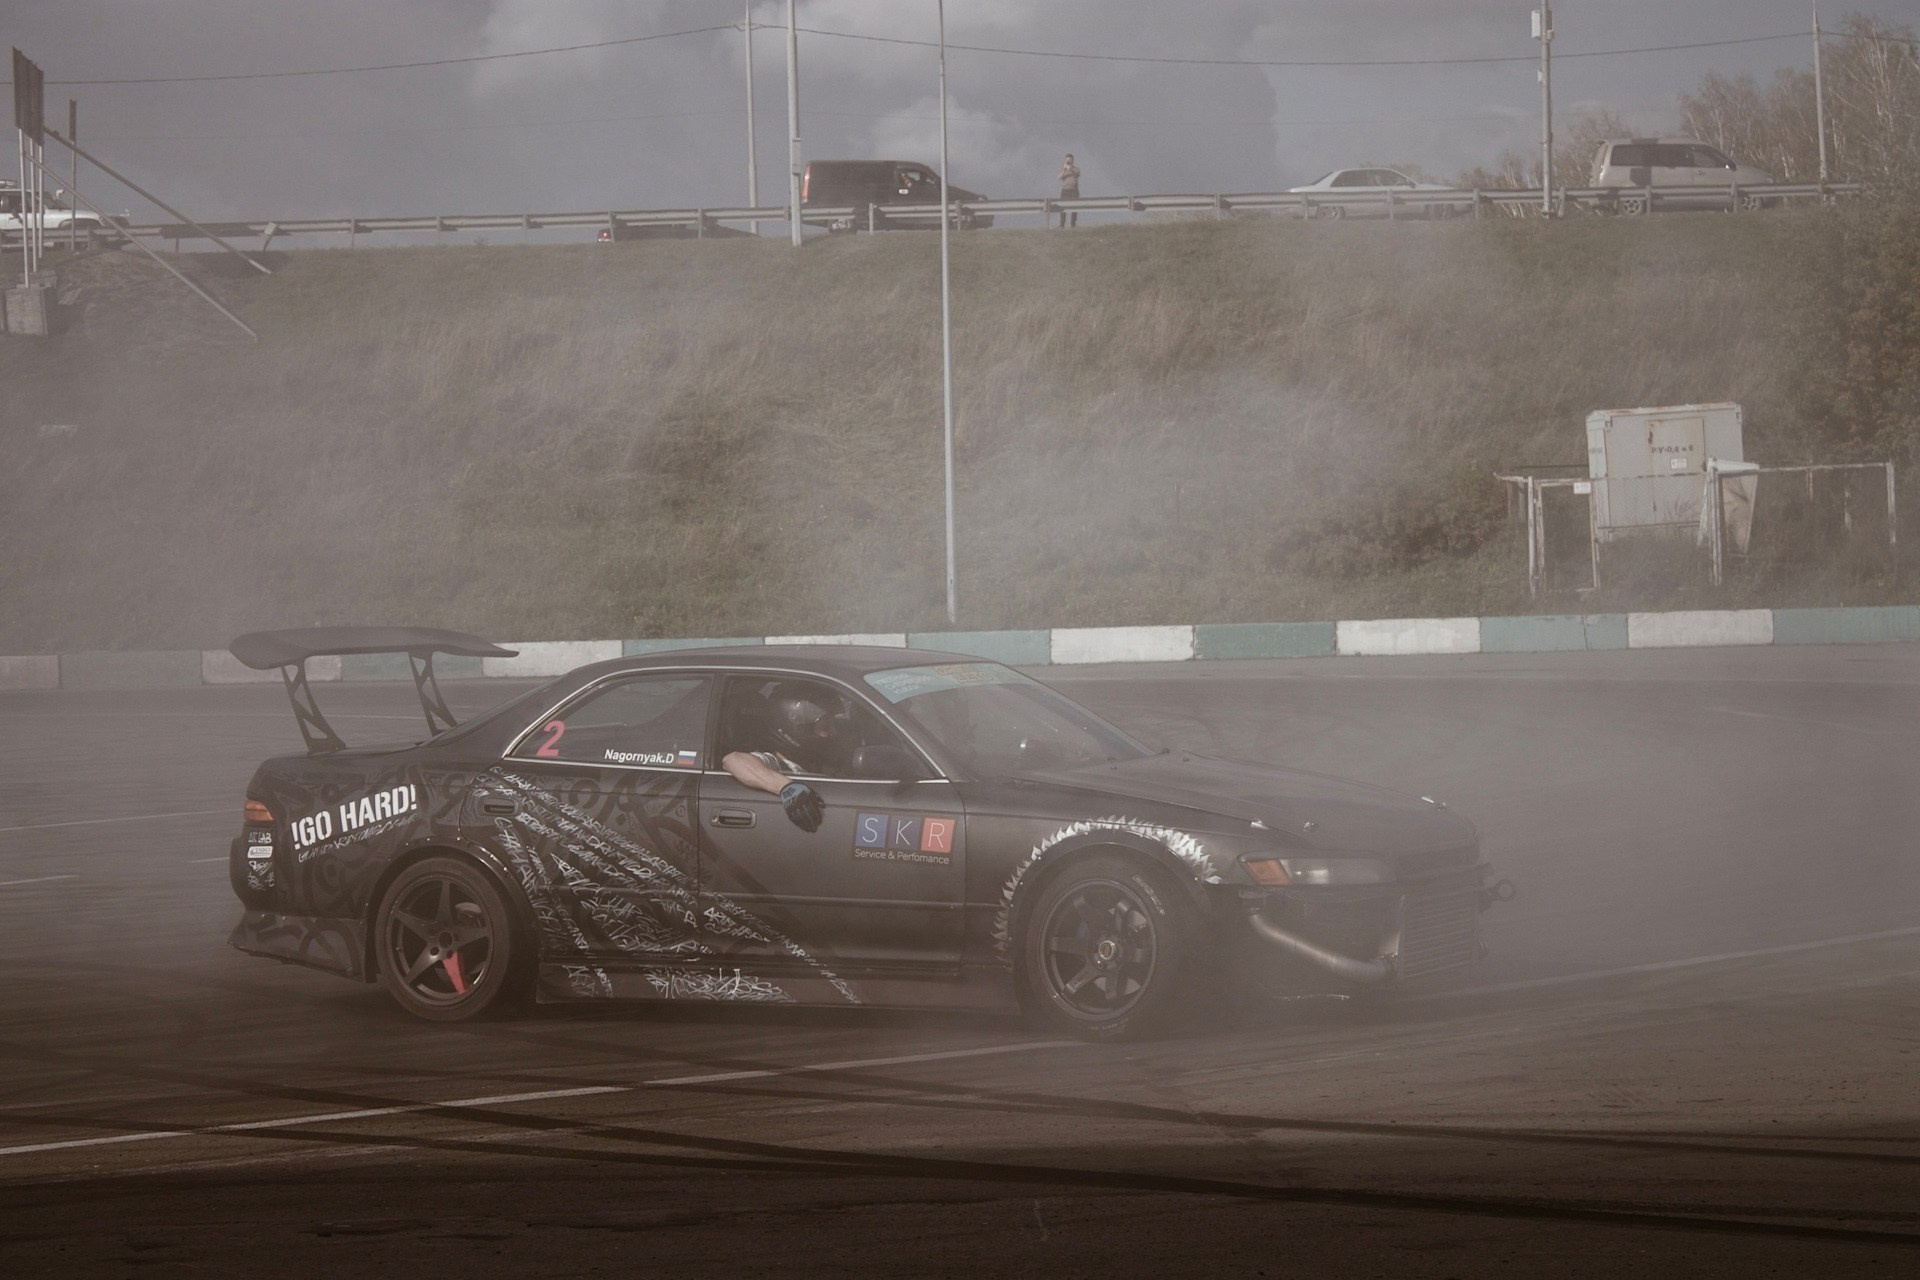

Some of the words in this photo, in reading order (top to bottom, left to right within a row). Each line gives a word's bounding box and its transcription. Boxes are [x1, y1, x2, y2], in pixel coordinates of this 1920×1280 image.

[536, 720, 565, 756] 2
[604, 749, 675, 765] Nagornyak.D
[291, 810, 333, 851] !GO
[340, 783, 418, 833] HARD!
[854, 848, 887, 859] Service
[888, 850, 896, 860] &
